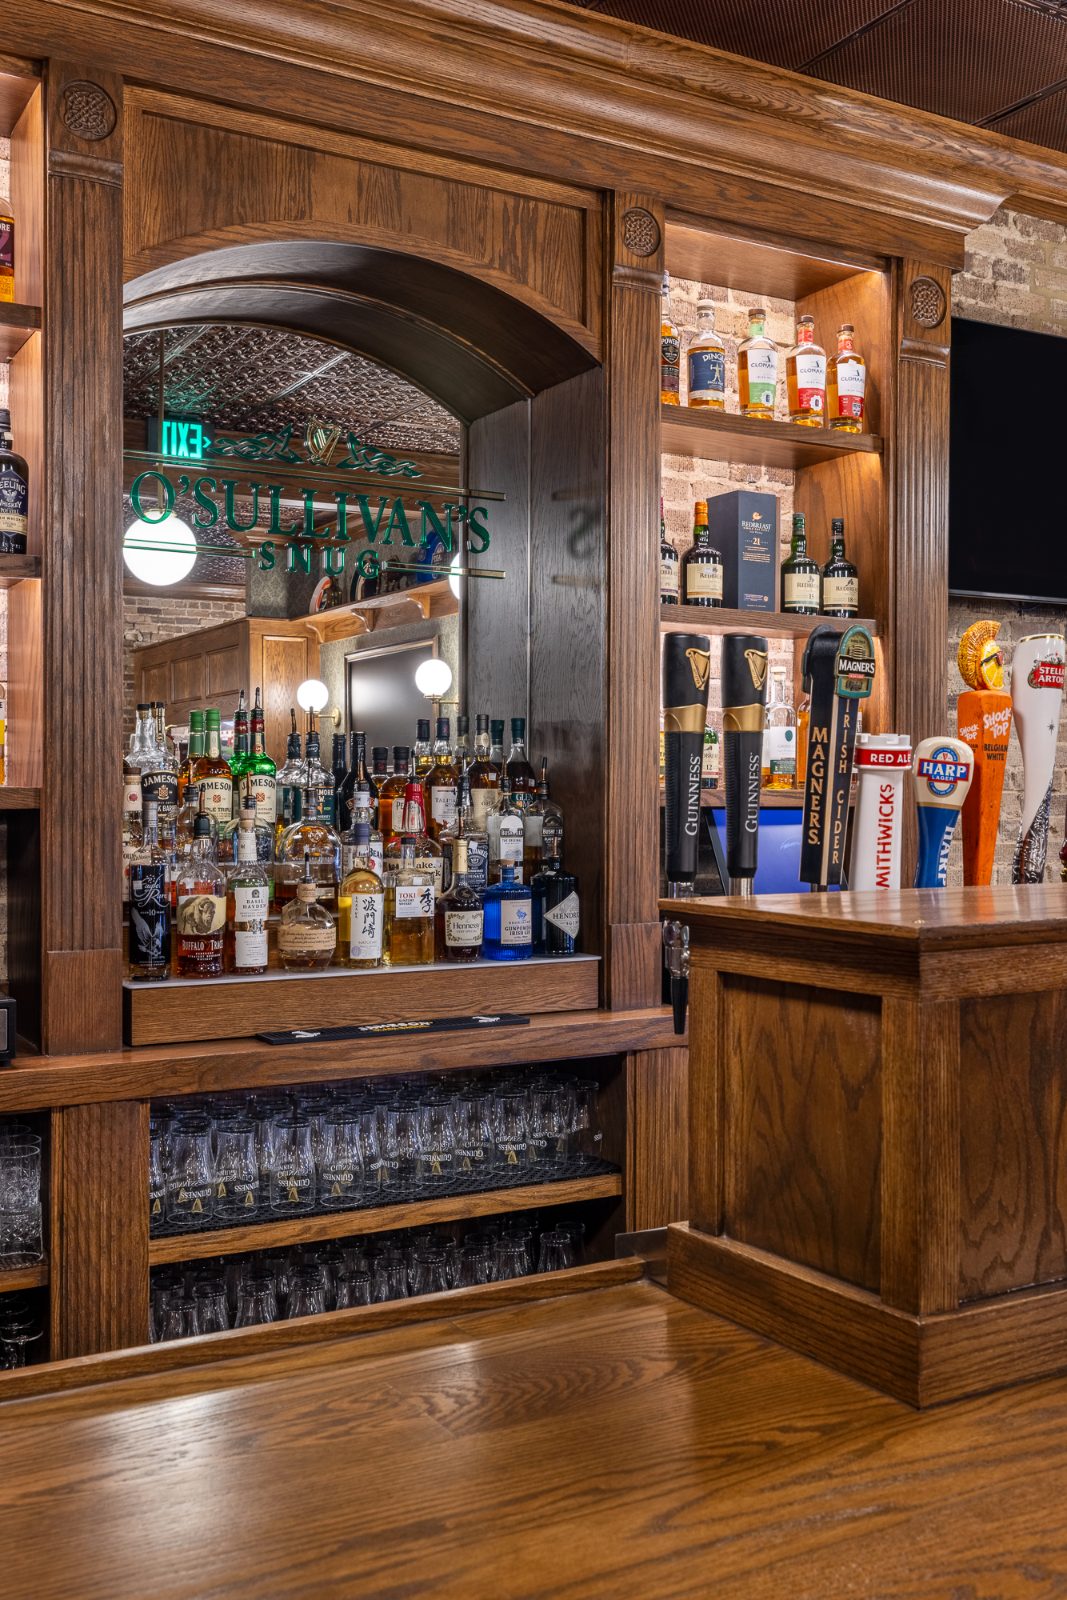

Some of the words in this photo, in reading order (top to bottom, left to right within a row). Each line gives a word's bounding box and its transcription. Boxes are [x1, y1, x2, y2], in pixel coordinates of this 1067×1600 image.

[130, 471, 491, 553] O'SULLIVAN'S
[753, 537, 761, 545] 21
[258, 541, 381, 579] SNUG
[839, 659, 875, 674] MAGNERS
[983, 707, 1012, 728] SHOCK
[838, 698, 850, 774] IRISH
[990, 722, 1009, 739] TOP
[870, 754, 894, 763] RED
[922, 761, 967, 778] HARP
[931, 774, 954, 782] LAGER
[684, 754, 701, 835] GUINNESS
[744, 753, 760, 833] GUINNESS
[831, 790, 845, 864] CIDER
[182, 940, 205, 951] BUFFALO
